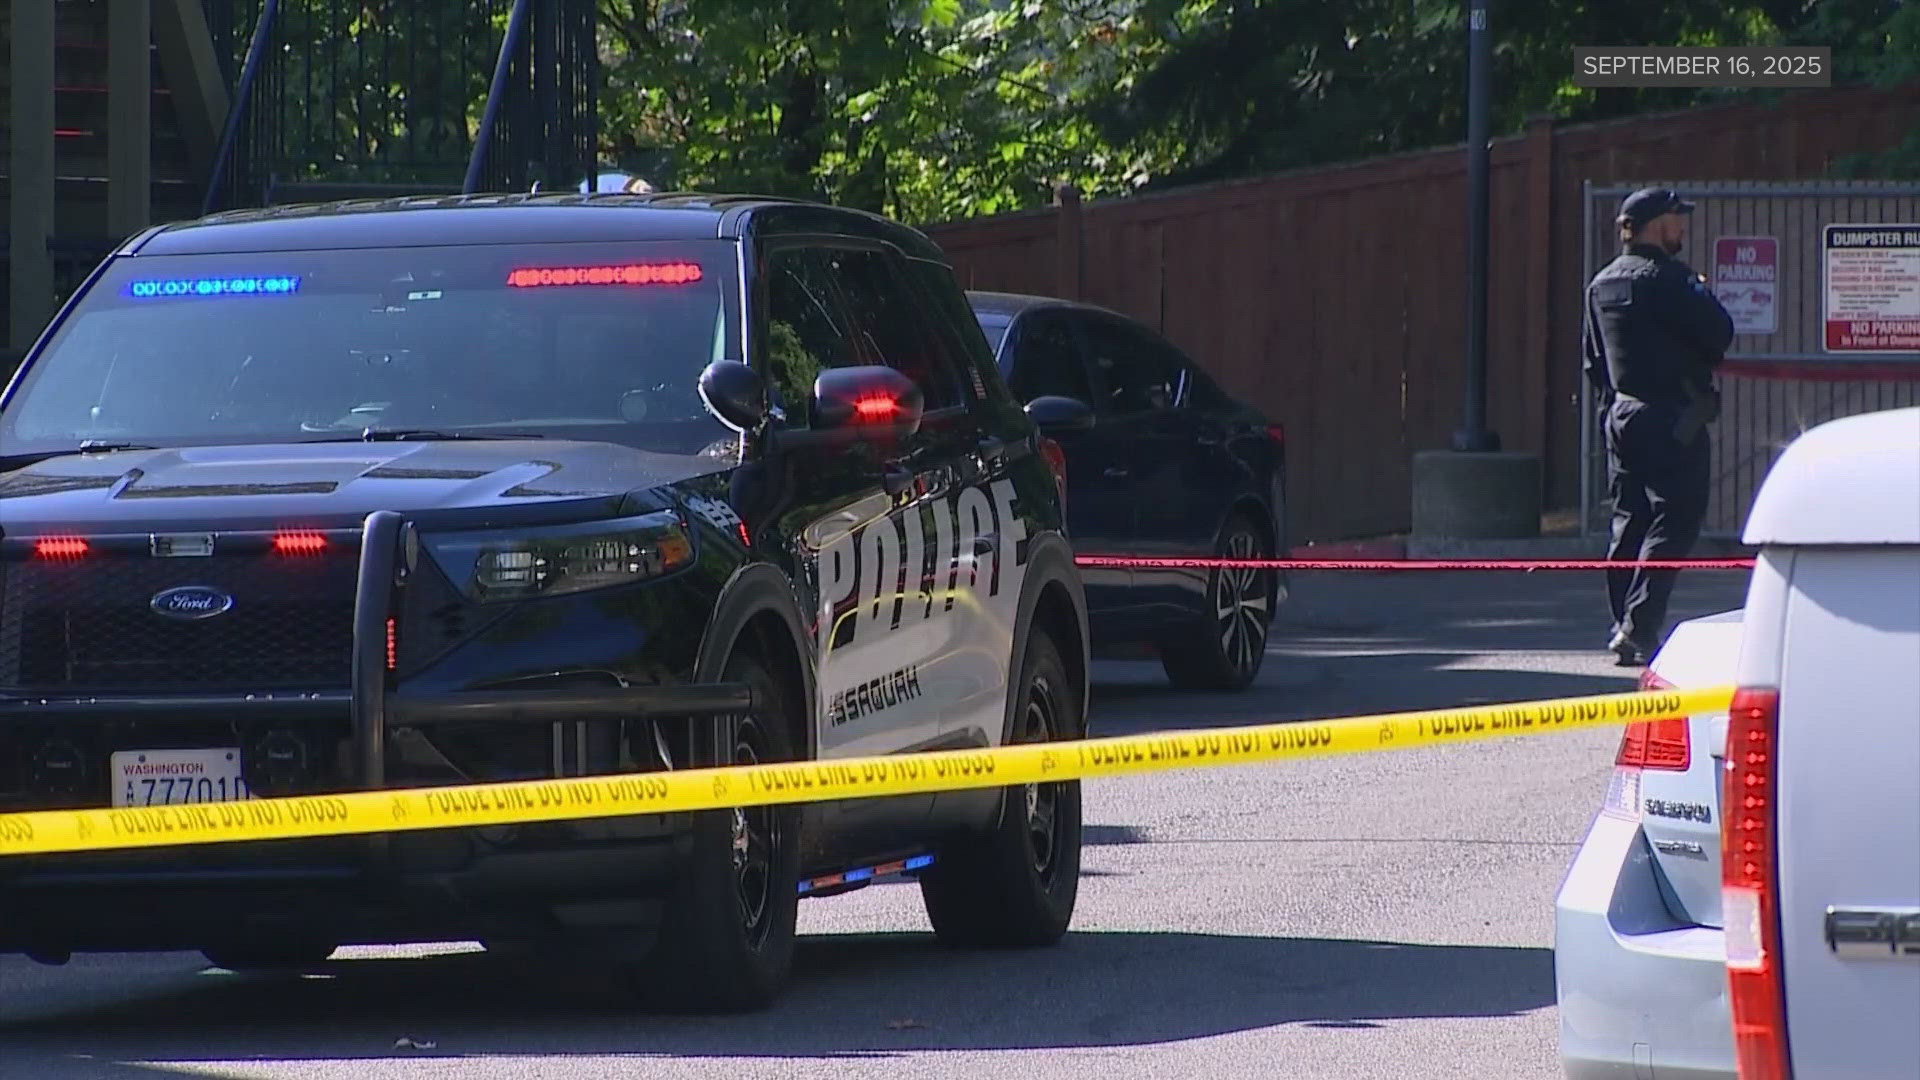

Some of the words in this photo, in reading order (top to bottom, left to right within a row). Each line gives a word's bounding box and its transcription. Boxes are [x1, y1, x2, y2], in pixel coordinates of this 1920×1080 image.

[1833, 231, 1902, 246] DUMPSTER
[1736, 246, 1757, 262] NO
[1718, 264, 1775, 280] PARKING
[1851, 322, 1870, 334] NO
[818, 478, 1028, 655] POLICE
[168, 594, 214, 610] Ford
[829, 665, 921, 728] ISSAQUAH
[1539, 706, 1565, 724] DO
[1572, 703, 1607, 721] NOT
[1195, 735, 1220, 756] DO
[1227, 732, 1261, 754] NOT
[123, 762, 204, 776] WASHINGTON
[748, 767, 812, 792] POLICE
[817, 764, 857, 786] LINE
[861, 762, 888, 782] DO
[892, 759, 926, 780] NOT
[934, 755, 995, 778] CROSS
[425, 791, 489, 815] POLICE
[492, 787, 534, 810] LINE
[536, 784, 562, 806] DO
[566, 782, 601, 804] NOT
[607, 779, 667, 801] CROSS
[110, 809, 173, 835] POLICE
[174, 806, 216, 830] LINE
[217, 803, 245, 827] DO
[247, 801, 282, 826] NOT
[285, 798, 347, 823] CROSS
